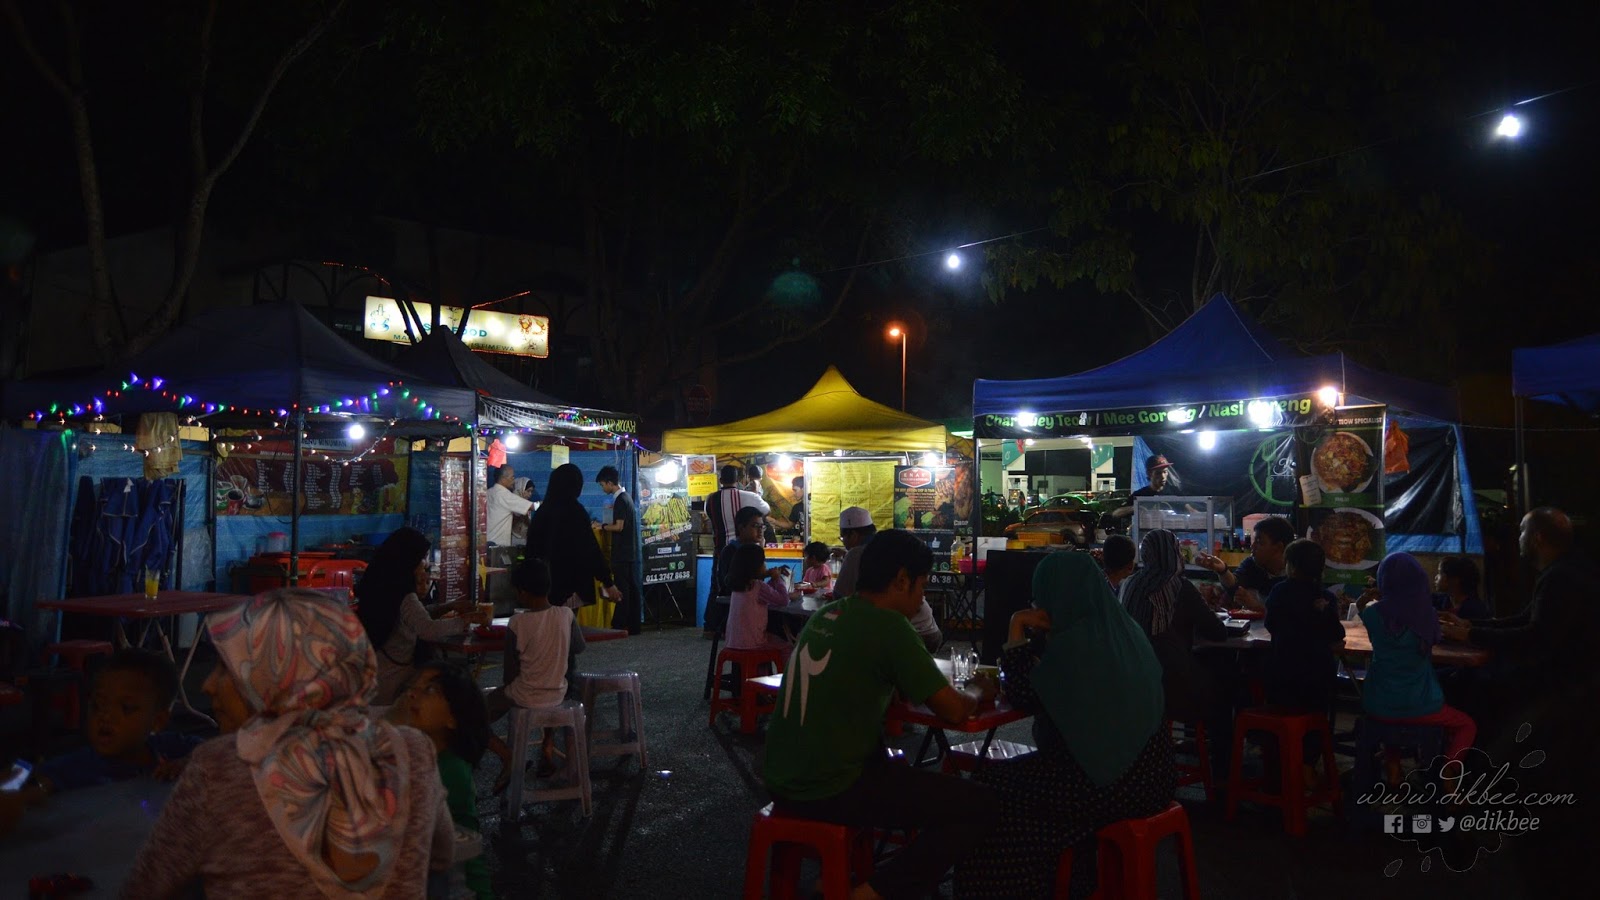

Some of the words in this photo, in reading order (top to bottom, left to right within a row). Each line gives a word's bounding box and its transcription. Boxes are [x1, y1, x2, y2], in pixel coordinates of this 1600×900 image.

[985, 414, 1014, 427] Char
[1104, 411, 1136, 426] Mee
[1138, 408, 1197, 424] Gorg
[1209, 400, 1244, 418] Nasi
[1249, 398, 1312, 416] reng
[645, 573, 659, 582] 011
[659, 572, 674, 581] 3747
